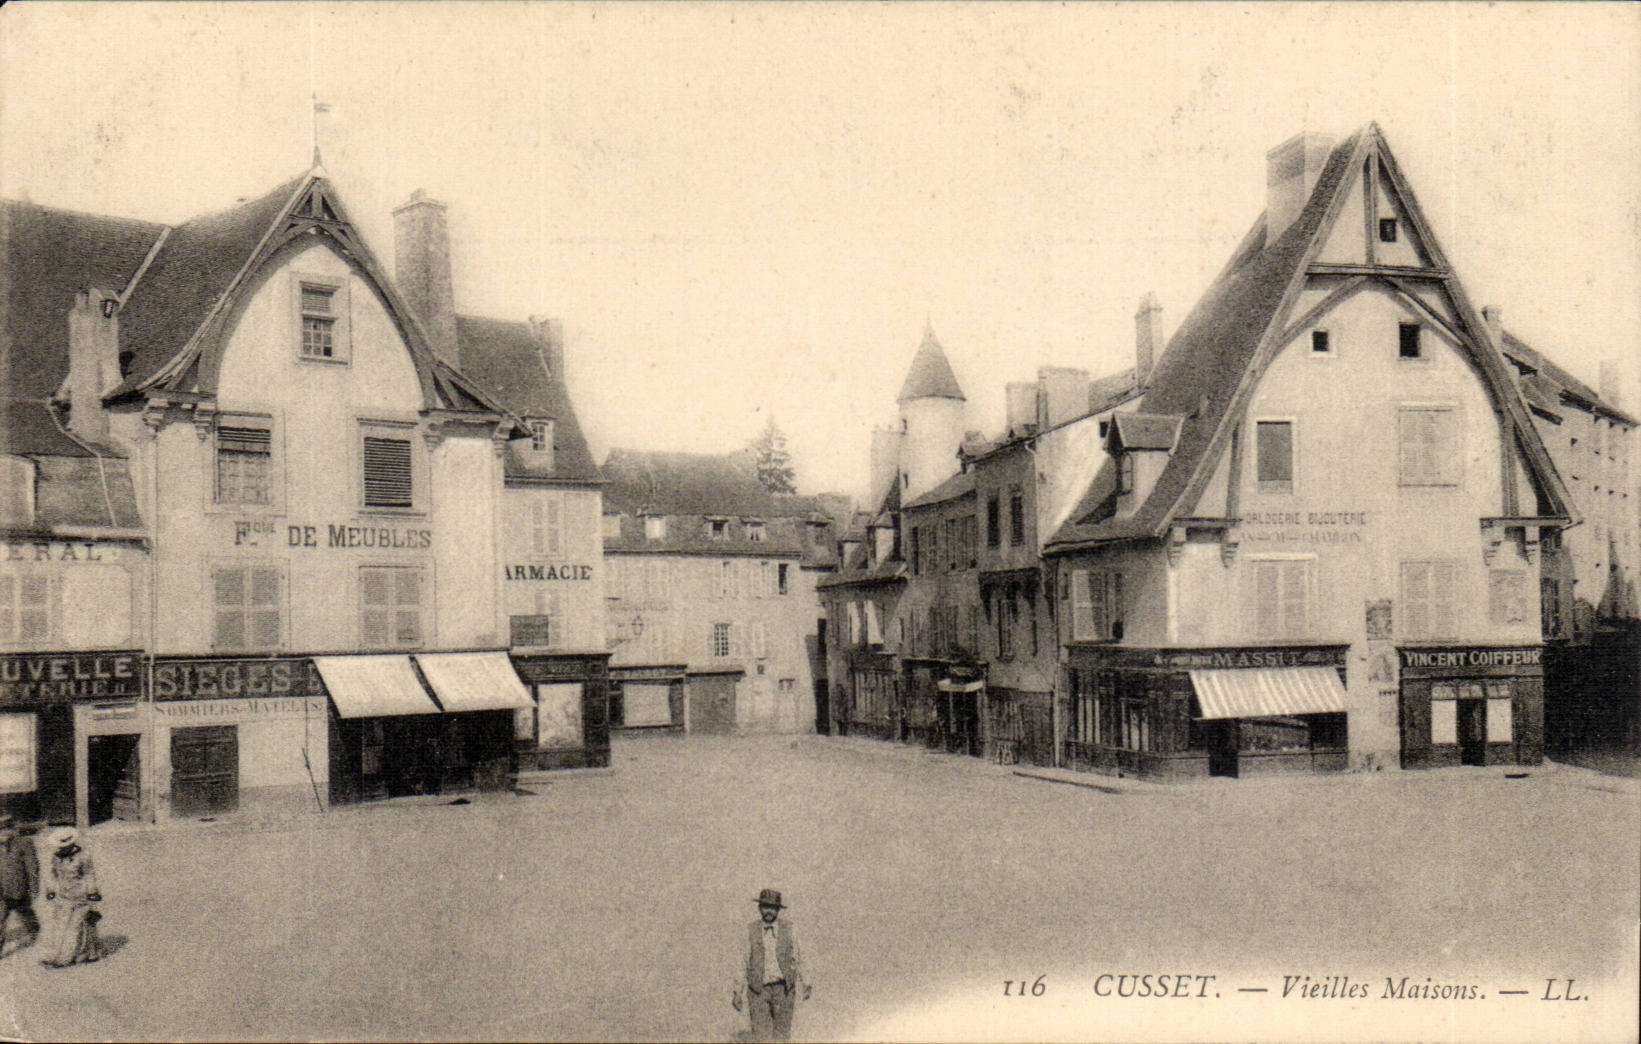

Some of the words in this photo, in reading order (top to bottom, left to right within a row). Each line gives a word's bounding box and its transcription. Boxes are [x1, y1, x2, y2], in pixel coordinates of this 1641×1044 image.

[288, 526, 317, 547] DE
[328, 524, 432, 549] MEUBLES
[1, 657, 134, 681] UVELLE
[1402, 651, 1467, 667] VINCENT
[1469, 650, 1541, 665] COIFFEUR
